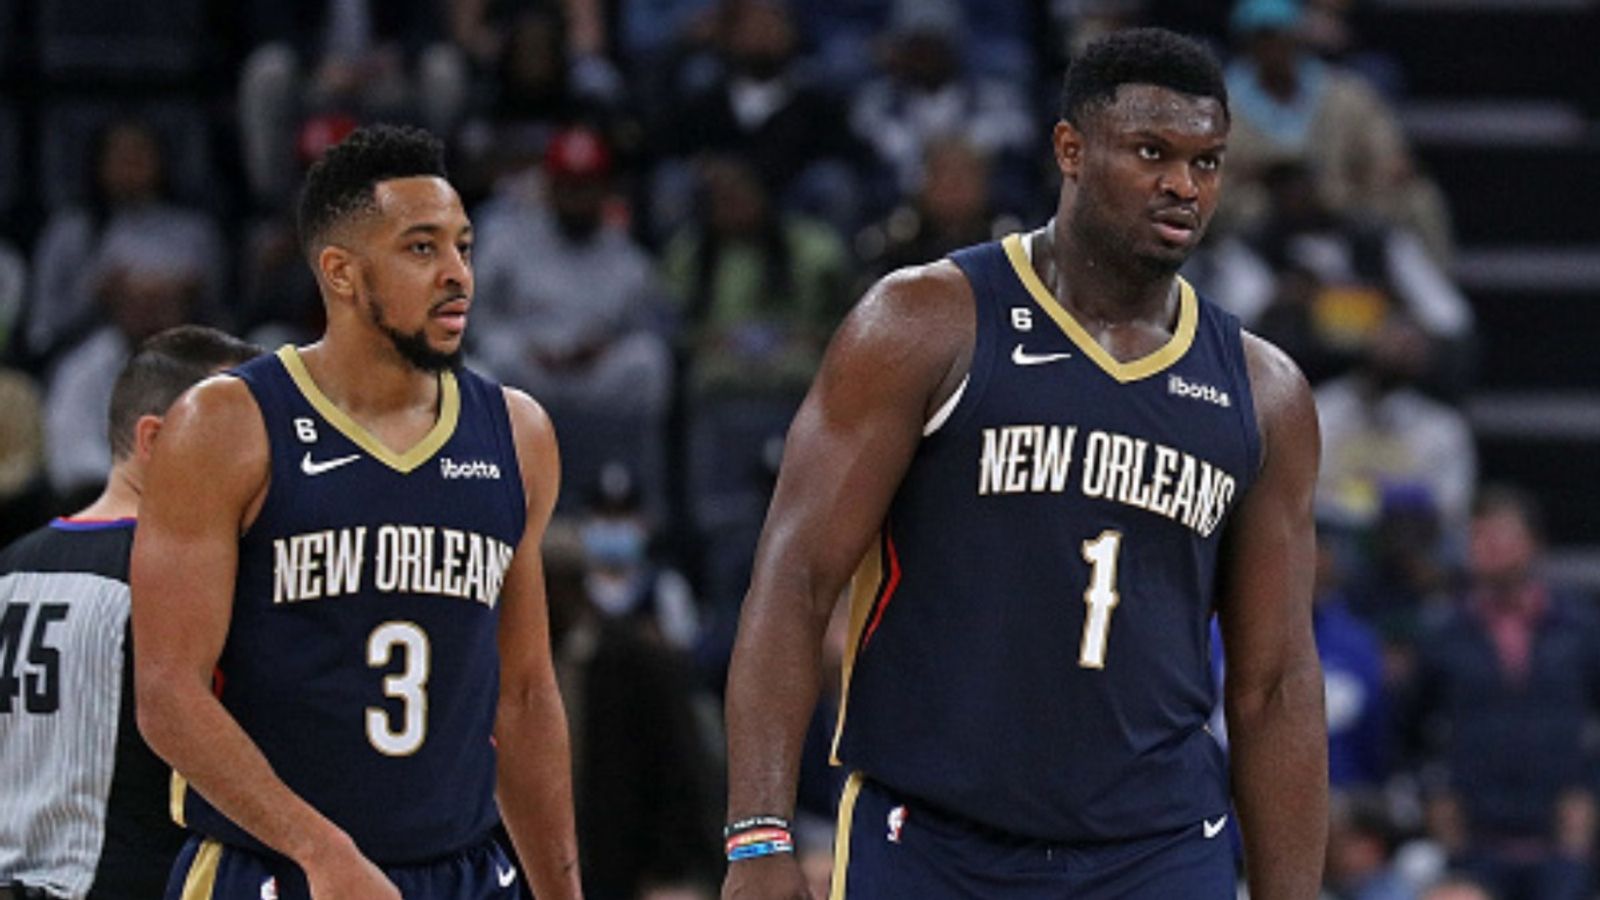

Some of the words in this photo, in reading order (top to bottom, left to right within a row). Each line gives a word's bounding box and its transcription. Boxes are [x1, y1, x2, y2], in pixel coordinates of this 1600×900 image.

[1011, 307, 1032, 331] 6
[1168, 374, 1231, 407] ibotta
[294, 417, 318, 443] 6
[440, 457, 501, 479] ibotta
[978, 424, 1078, 496] NEW
[1081, 430, 1236, 538] ORLEANS
[273, 526, 367, 604] NEW
[1078, 529, 1123, 669] 1
[0, 602, 70, 714] 45
[365, 620, 431, 757] 3
